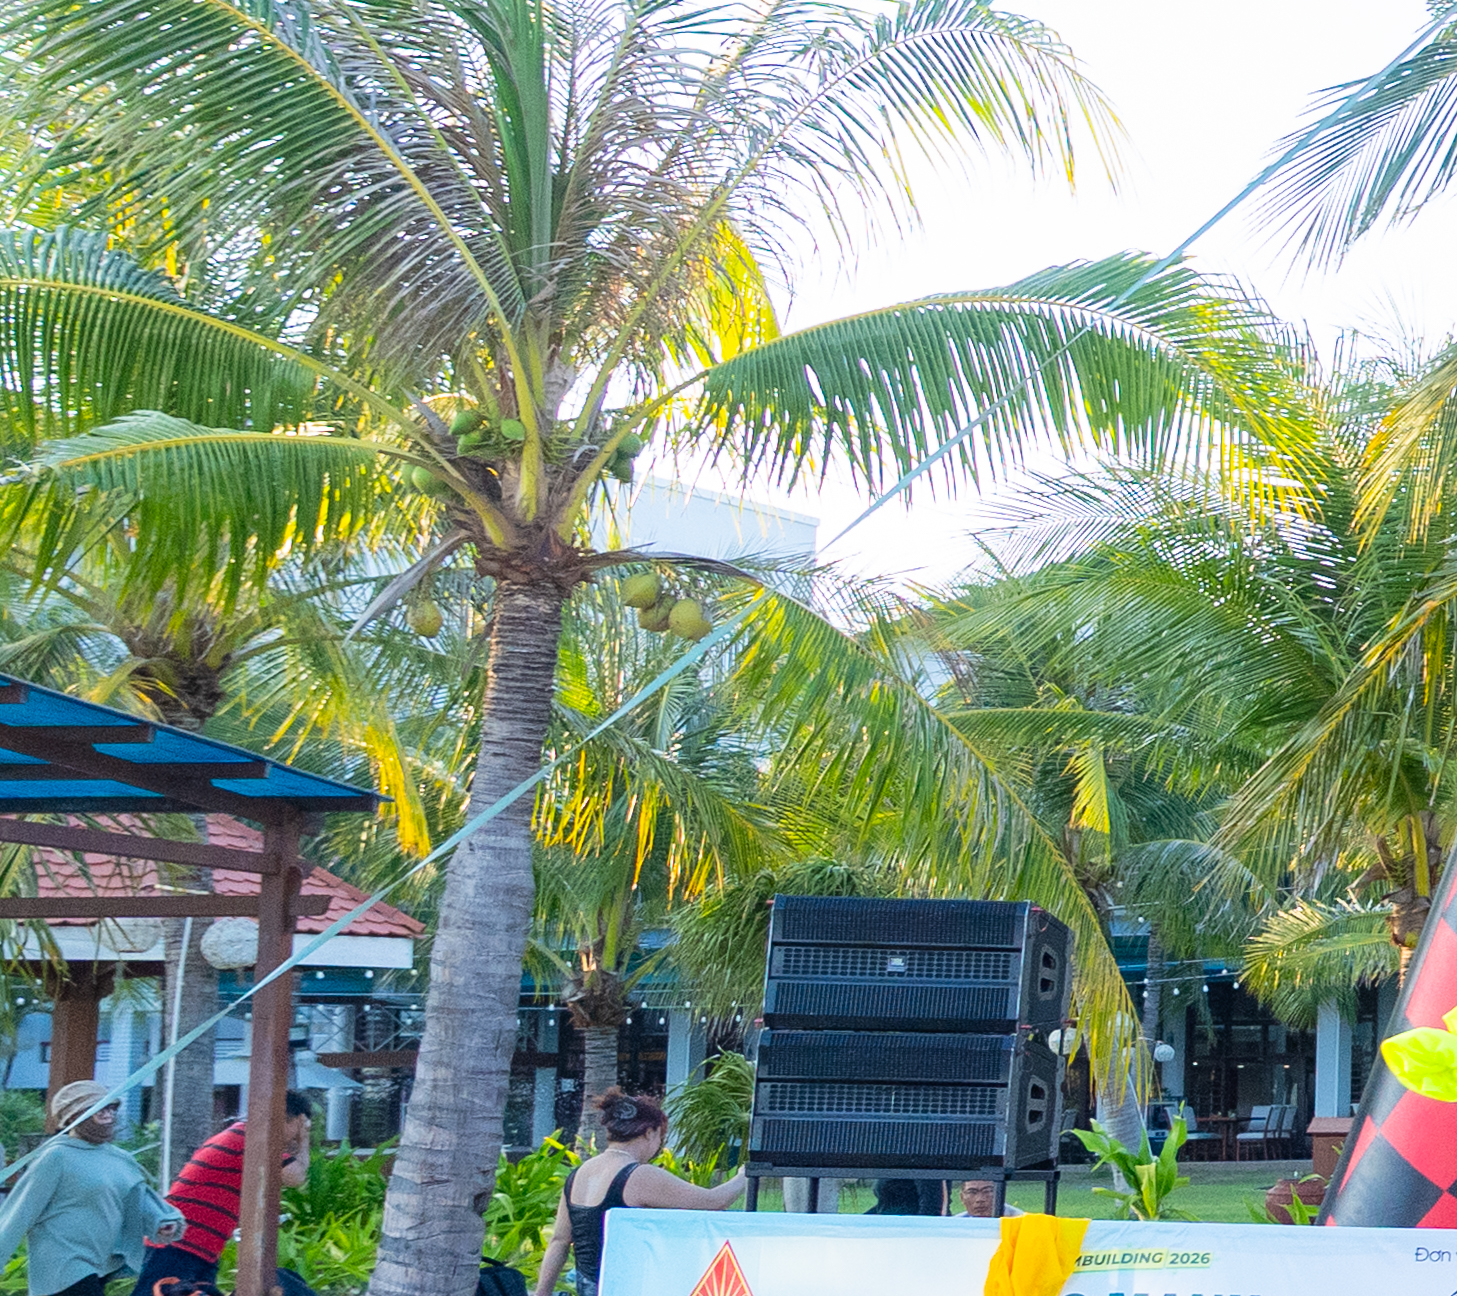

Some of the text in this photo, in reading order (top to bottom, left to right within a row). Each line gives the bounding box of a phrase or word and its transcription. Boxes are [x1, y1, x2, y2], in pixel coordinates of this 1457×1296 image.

[1074, 1252, 1211, 1267] MBUILDING 2026
[1415, 1247, 1451, 1262] Đơn
